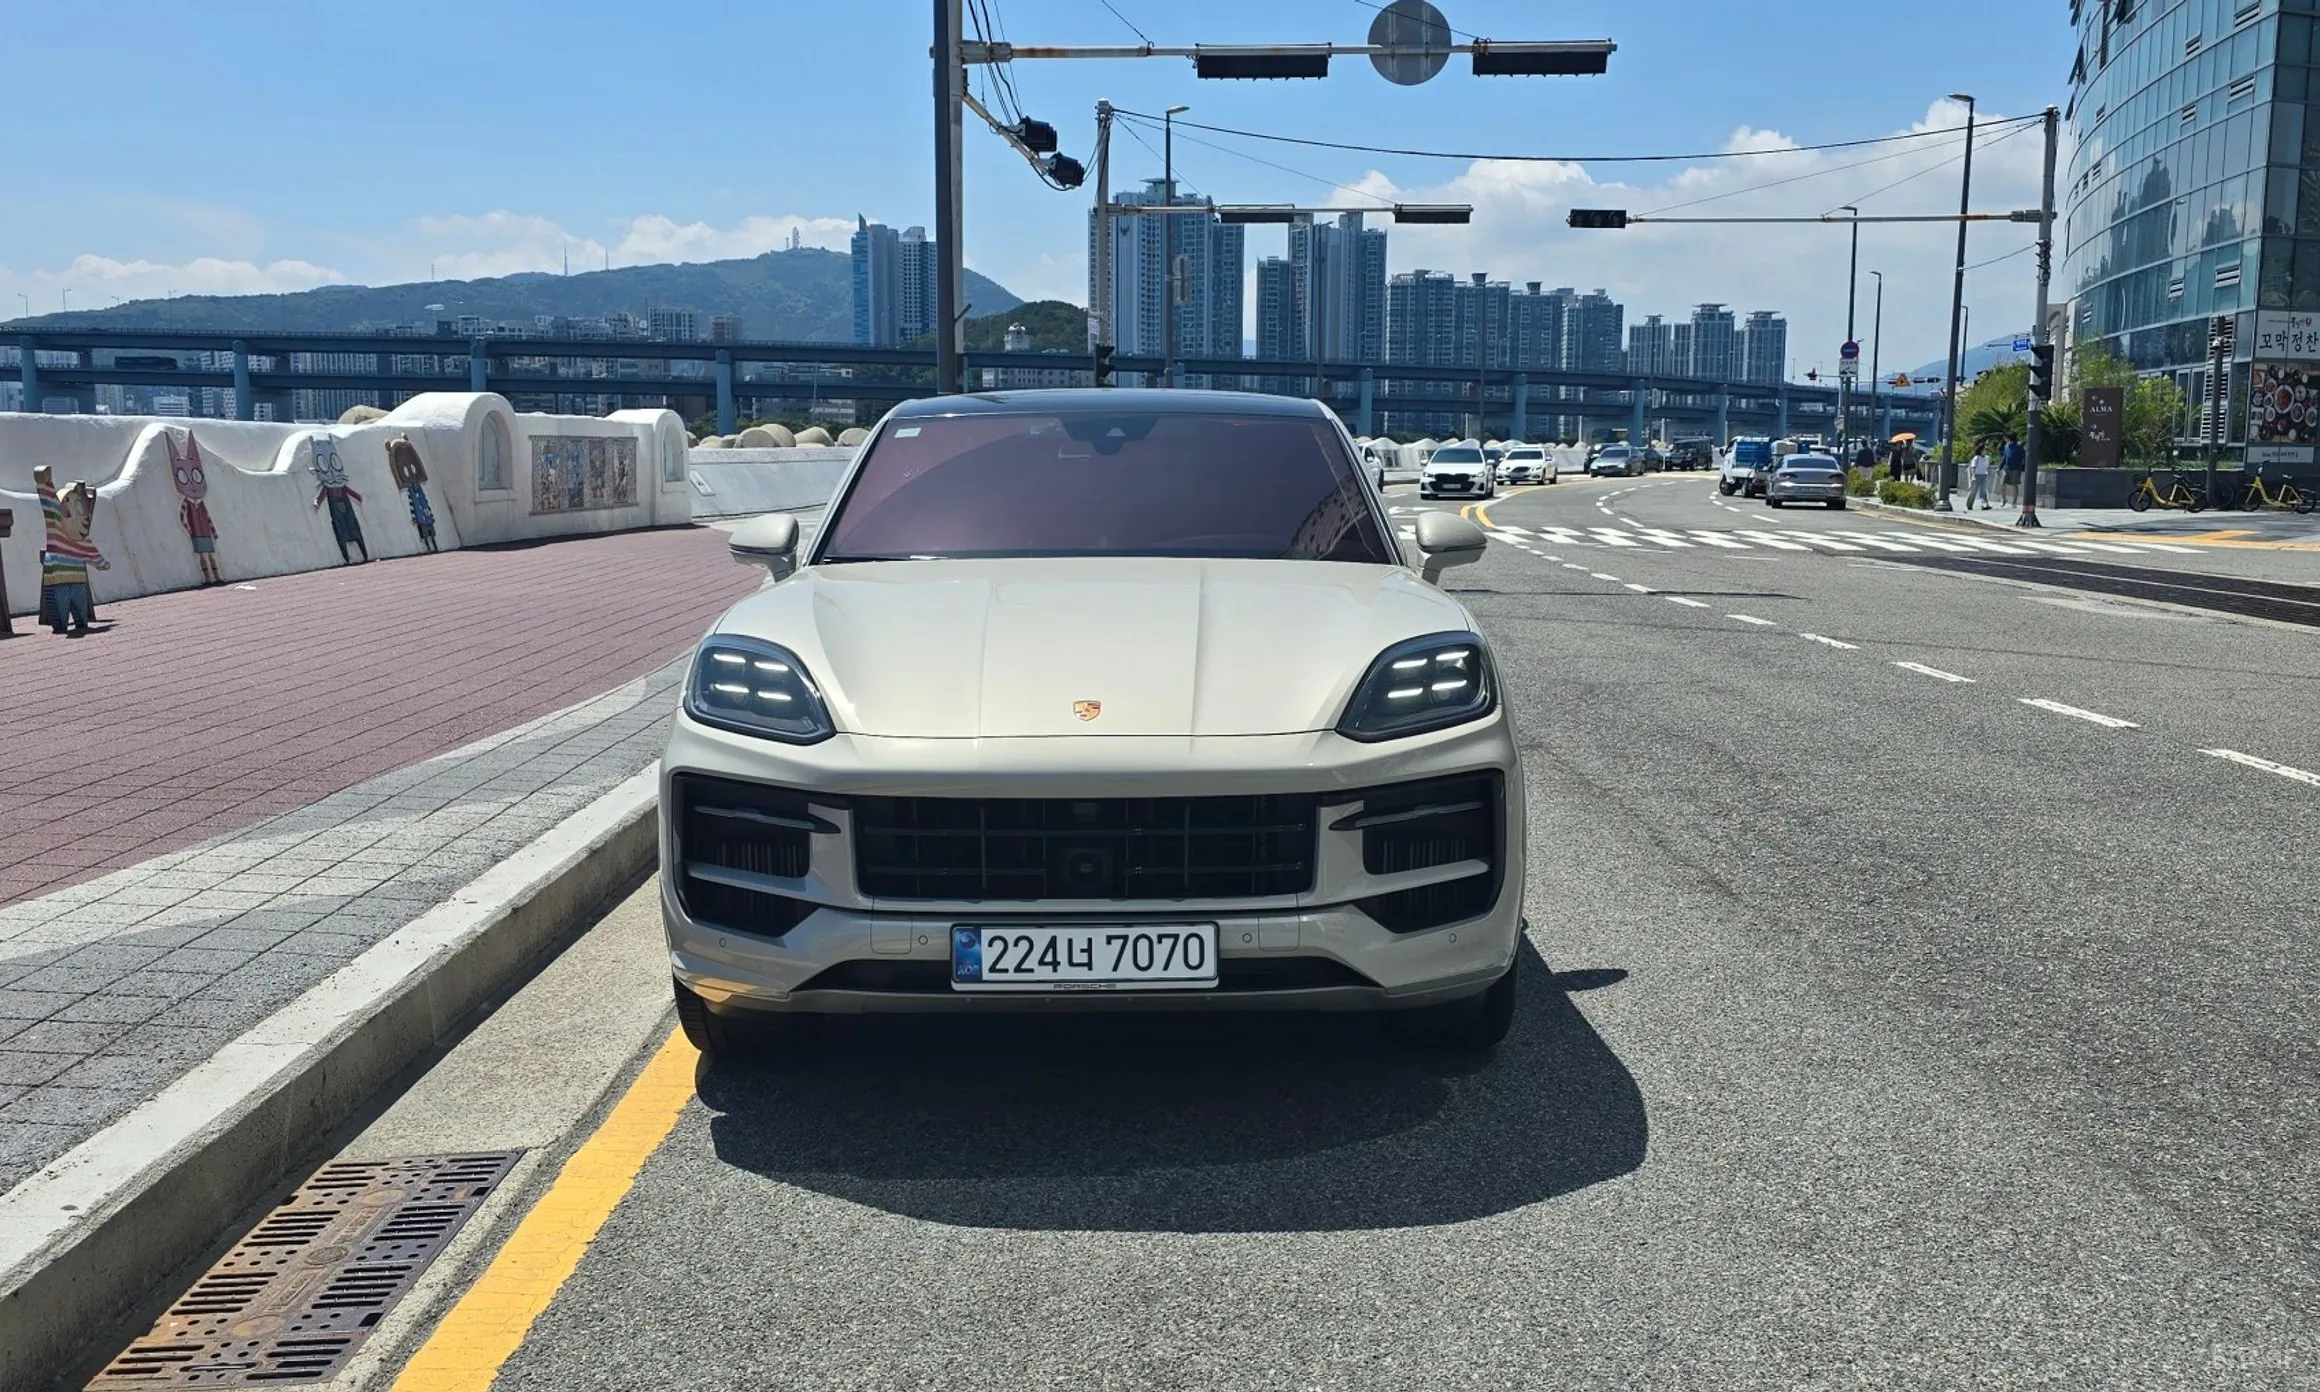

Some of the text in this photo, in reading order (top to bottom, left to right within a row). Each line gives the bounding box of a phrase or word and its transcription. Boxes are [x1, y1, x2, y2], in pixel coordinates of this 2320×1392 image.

[2089, 405, 2113, 413] ALMA
[987, 932, 1205, 973] 224너 7070
